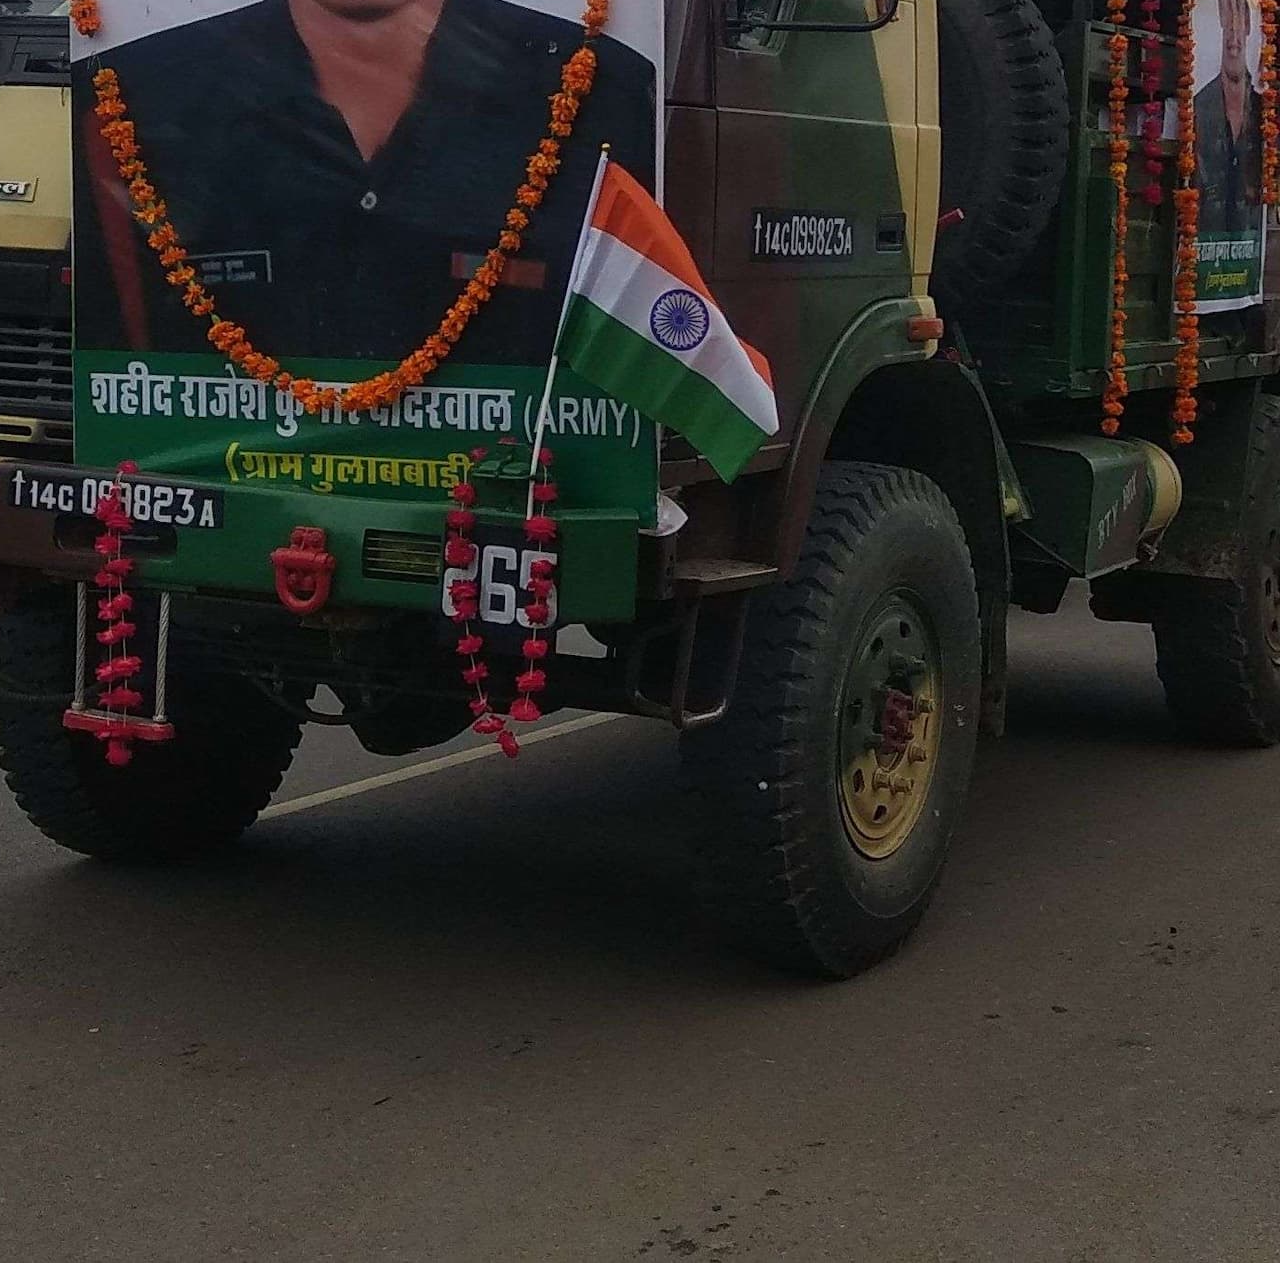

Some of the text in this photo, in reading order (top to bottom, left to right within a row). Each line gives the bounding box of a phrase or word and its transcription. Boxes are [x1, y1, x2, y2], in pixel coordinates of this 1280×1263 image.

[89, 361, 175, 417] शहीद
[178, 363, 269, 421] राजेश
[225, 441, 305, 482] (ग्राम
